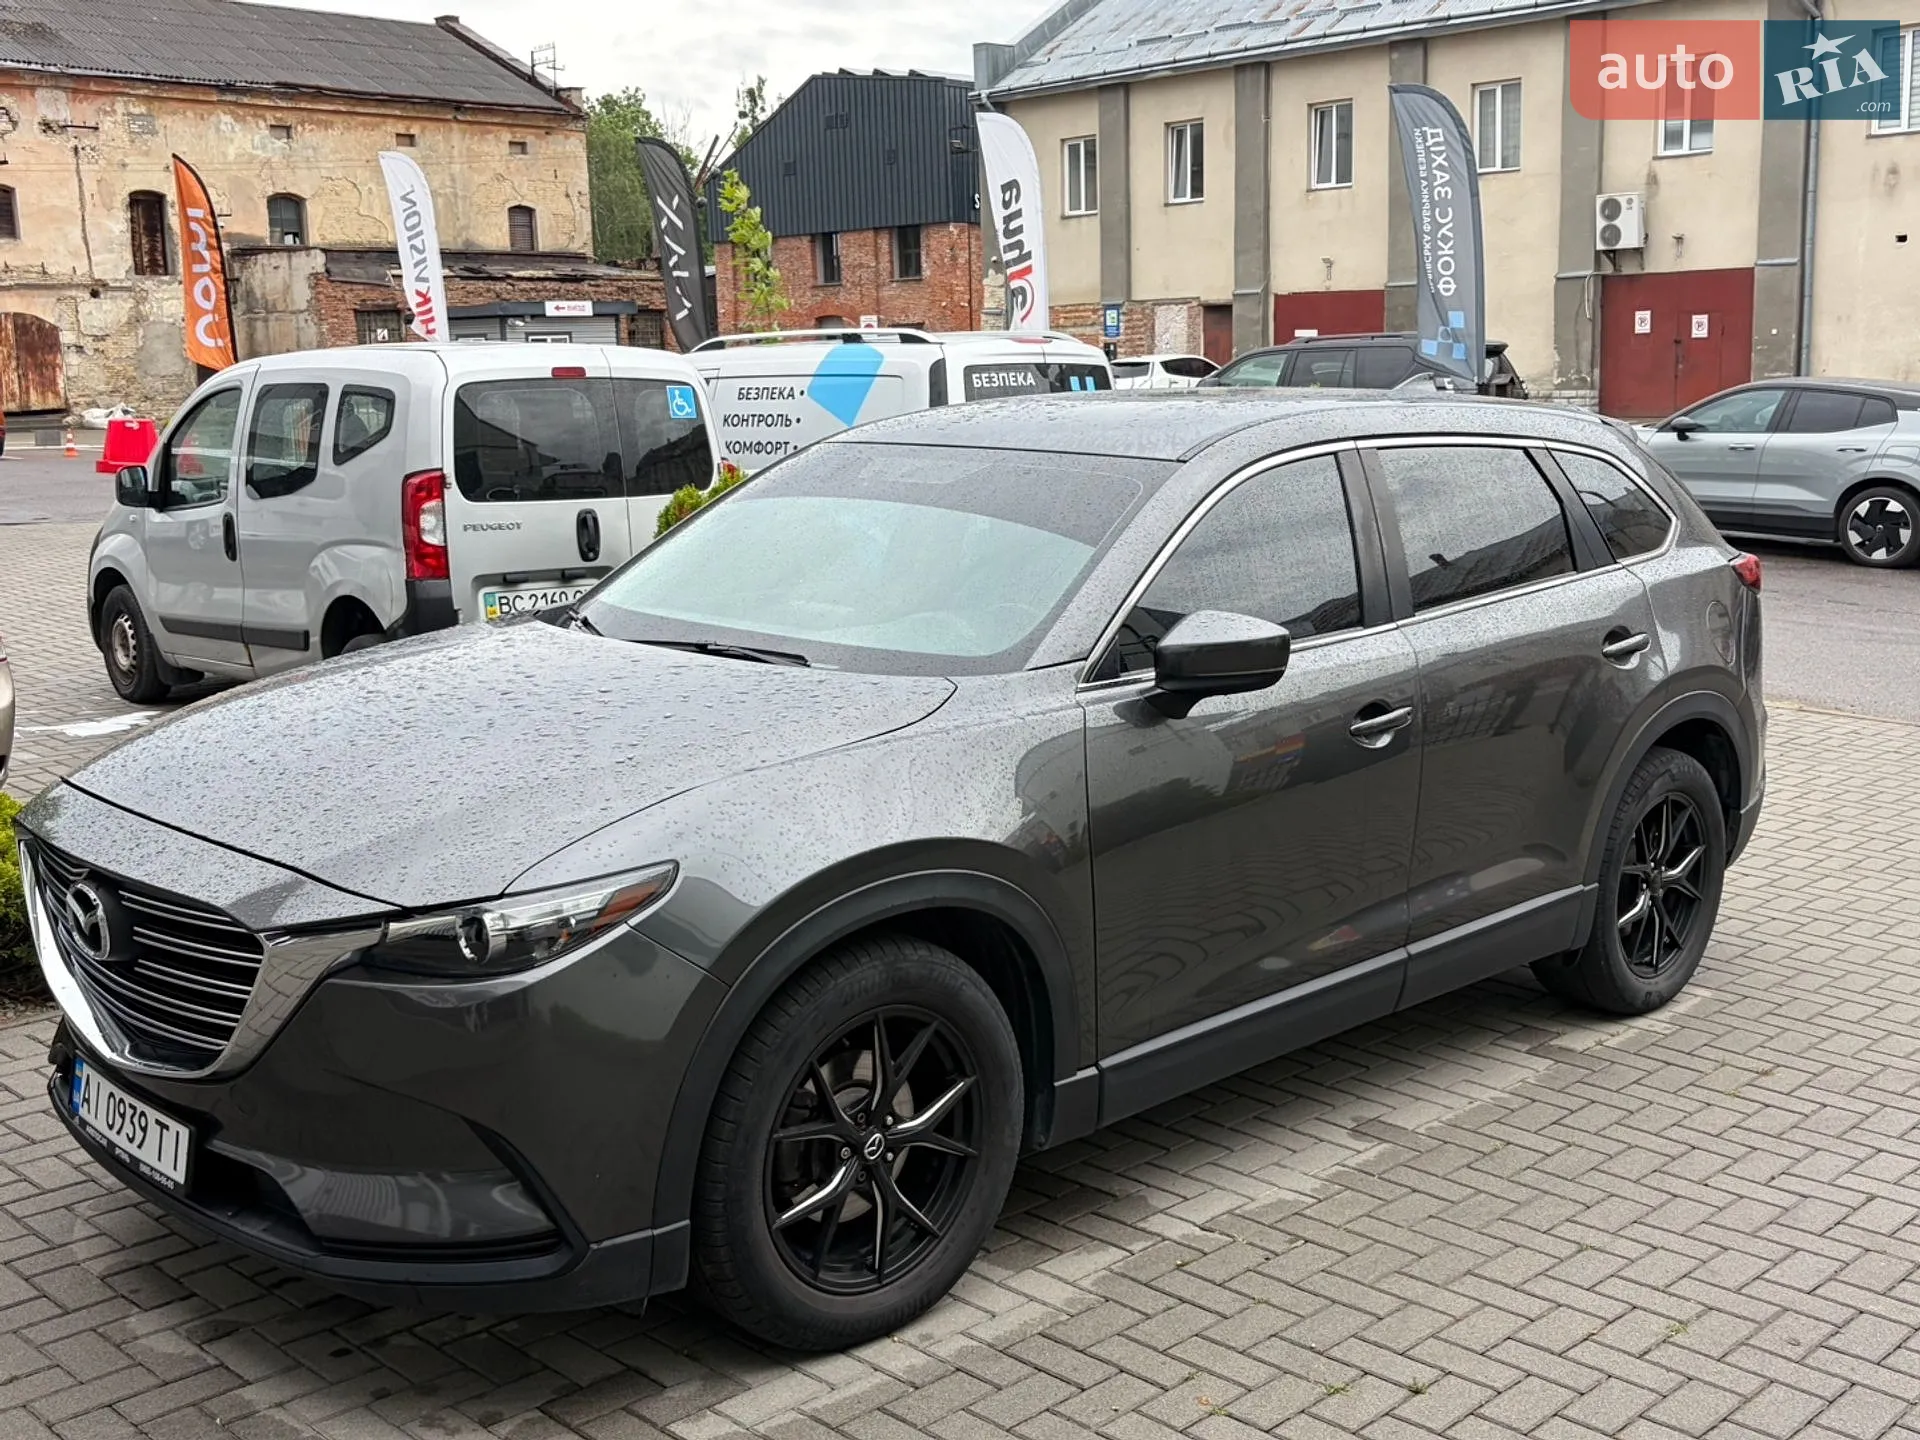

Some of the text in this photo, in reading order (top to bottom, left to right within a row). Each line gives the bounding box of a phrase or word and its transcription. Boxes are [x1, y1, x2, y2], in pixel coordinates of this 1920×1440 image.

[972, 373, 1035, 388] БЕЗПЕКА
[737, 386, 796, 401] БЕЗПЕКА
[723, 413, 792, 428] КОНТРОЛЬ
[463, 521, 523, 532] PEUGEOT
[498, 595, 524, 614] BC
[82, 1074, 101, 1119] AI
[107, 1092, 148, 1149] 0939
[156, 1120, 180, 1171] TI
